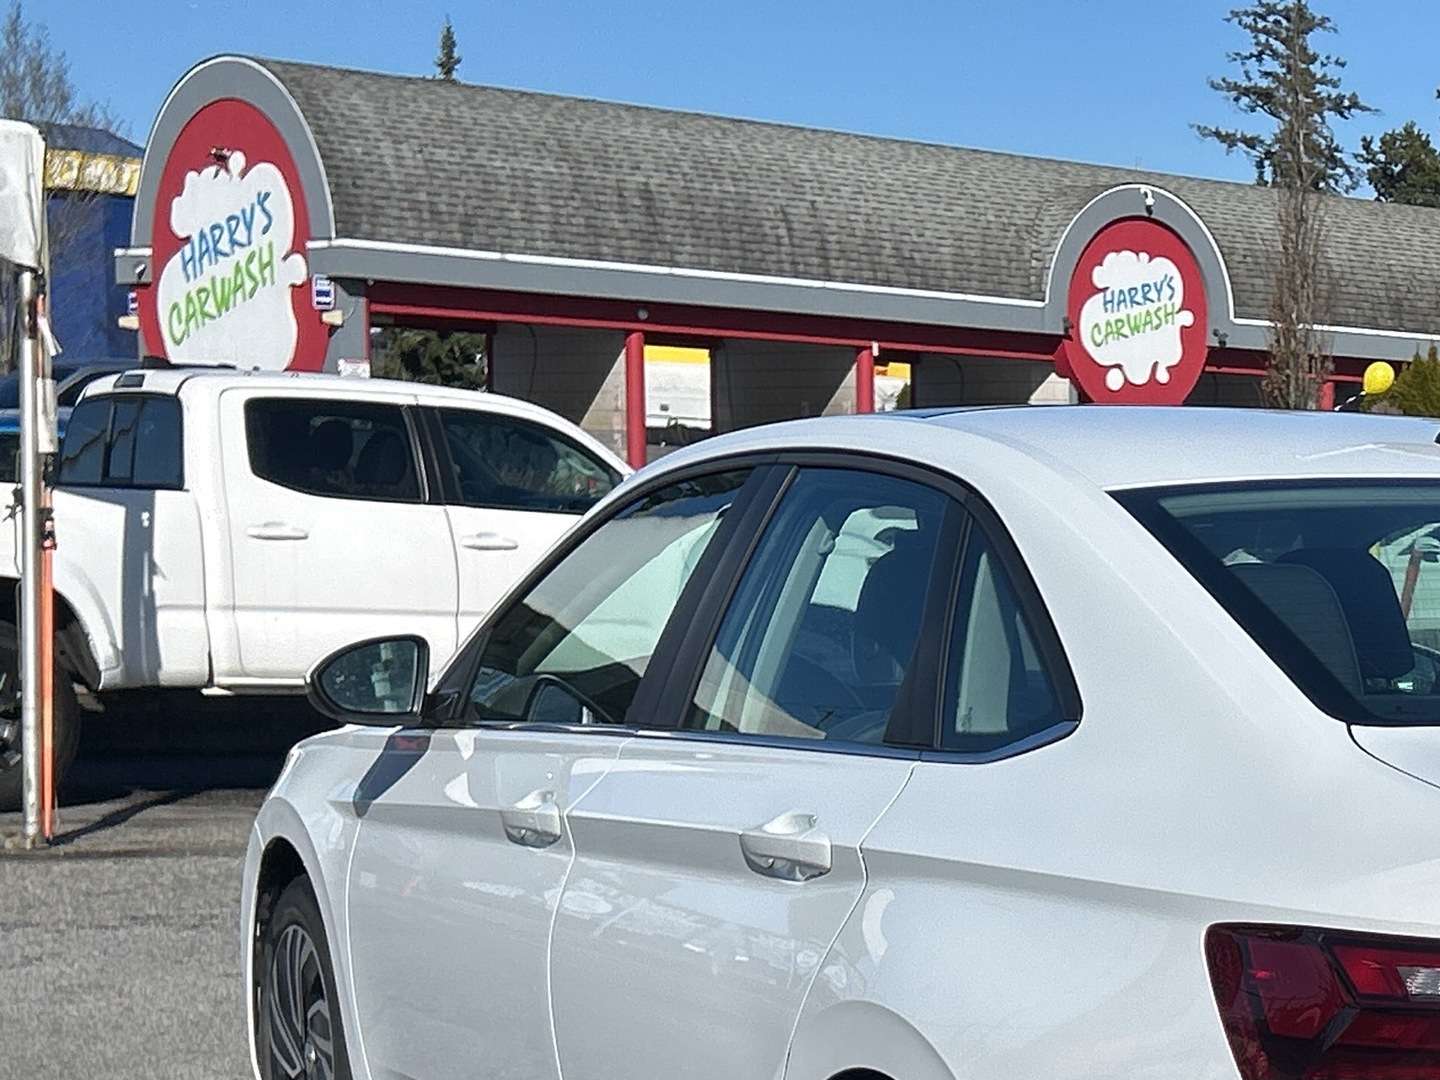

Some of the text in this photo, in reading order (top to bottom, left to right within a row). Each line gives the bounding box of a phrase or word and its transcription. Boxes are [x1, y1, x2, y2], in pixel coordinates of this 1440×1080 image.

[180, 191, 273, 283] HARRY'S
[168, 241, 276, 347] CARWASH
[1091, 302, 1176, 347] CARWASH
[1102, 274, 1175, 314] HARRY'S
